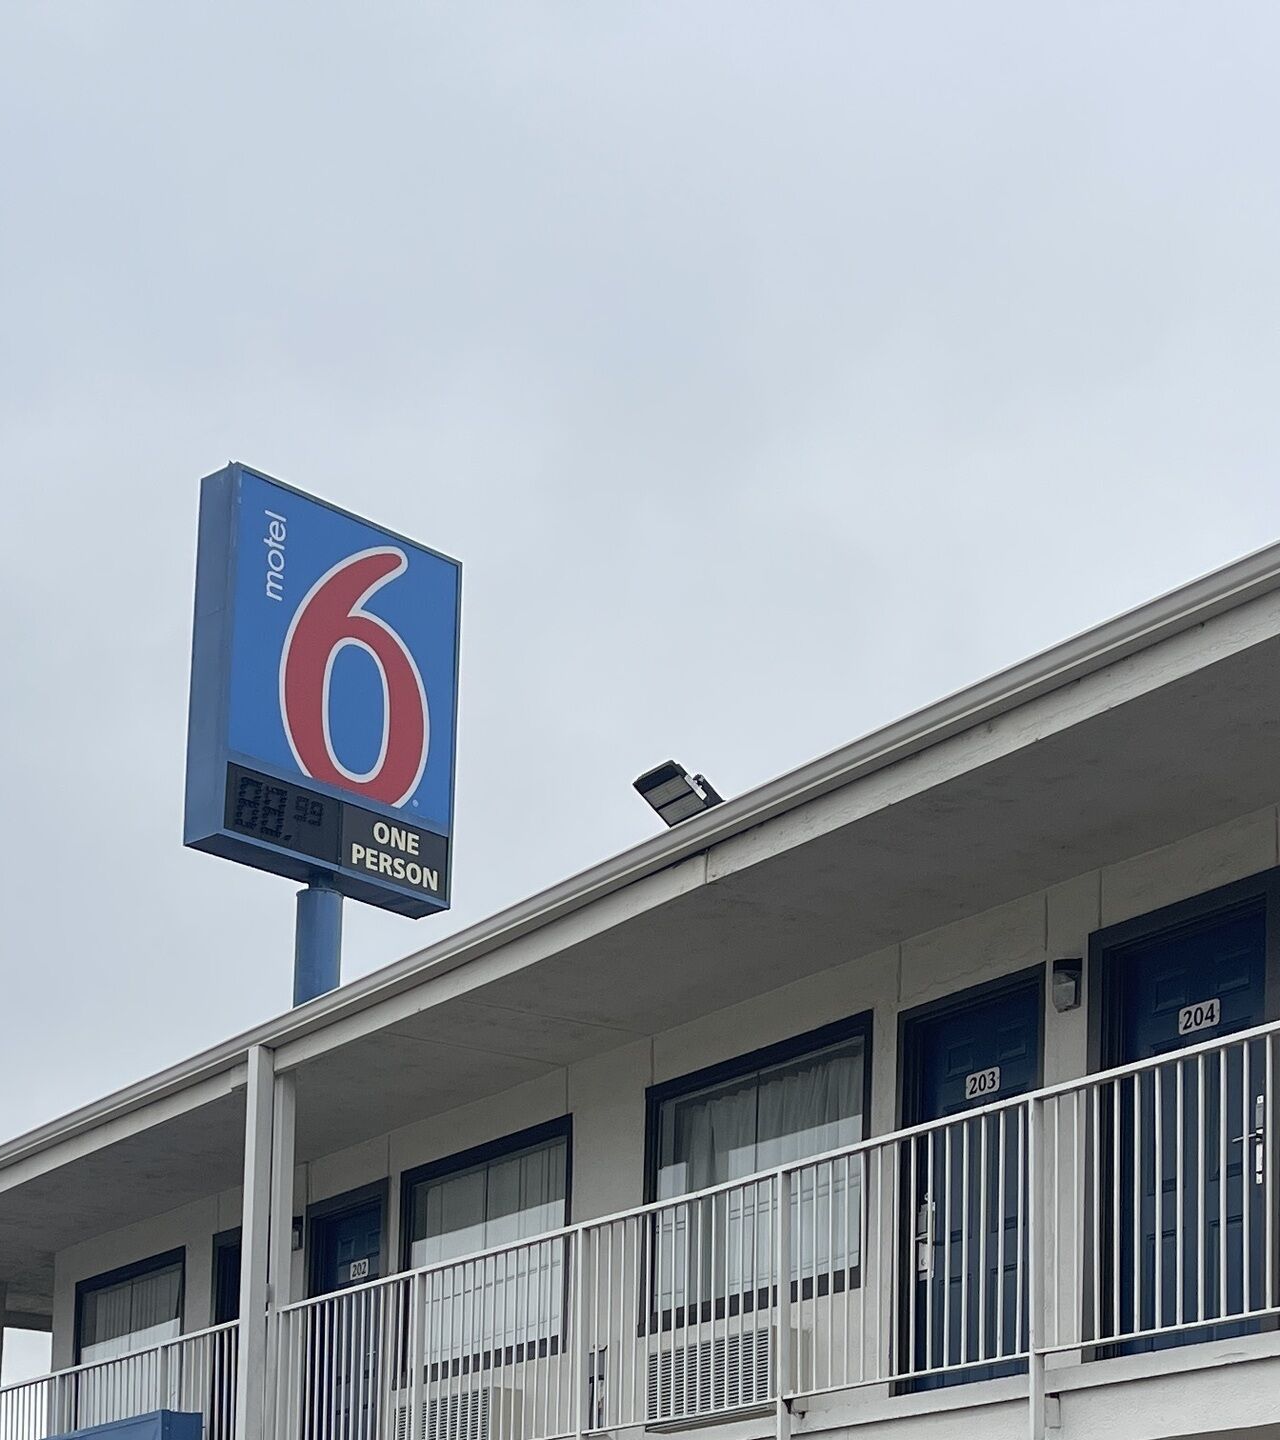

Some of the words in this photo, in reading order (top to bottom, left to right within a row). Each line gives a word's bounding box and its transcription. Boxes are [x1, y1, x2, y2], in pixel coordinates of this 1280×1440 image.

[265, 510, 287, 601] motel
[279, 546, 430, 808] 6
[373, 821, 420, 855] ONE
[351, 843, 439, 892] PERSON
[1183, 1003, 1215, 1031] 204
[969, 1071, 996, 1095] 203
[352, 1261, 367, 1278] 202
